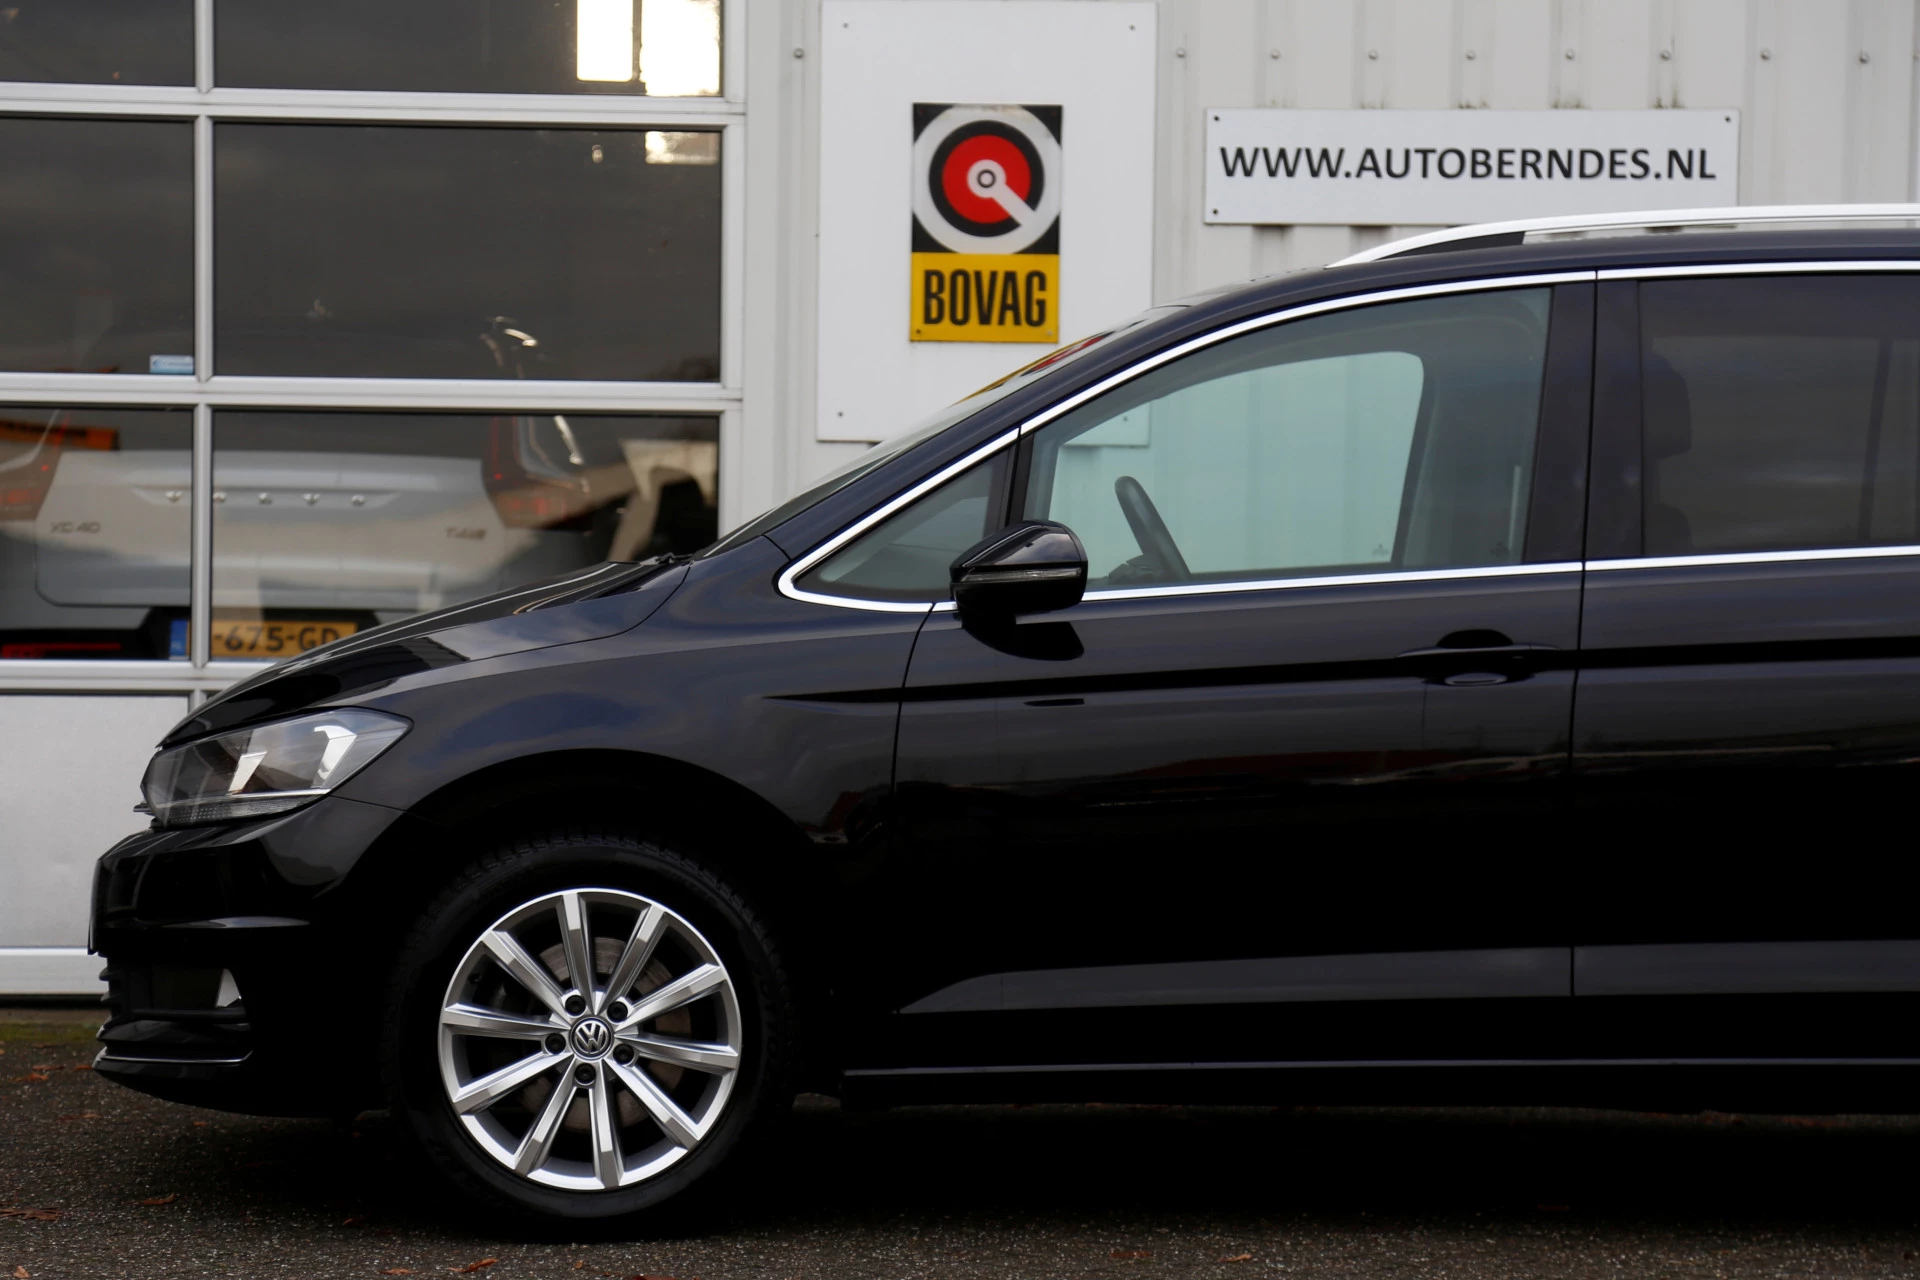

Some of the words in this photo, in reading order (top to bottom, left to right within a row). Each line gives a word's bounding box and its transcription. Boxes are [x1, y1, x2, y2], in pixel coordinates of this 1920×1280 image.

[1219, 147, 1717, 180] WWW.AUTOBERNDES.NL
[923, 268, 1047, 328] BOVAG
[213, 625, 341, 652] -675-GD
